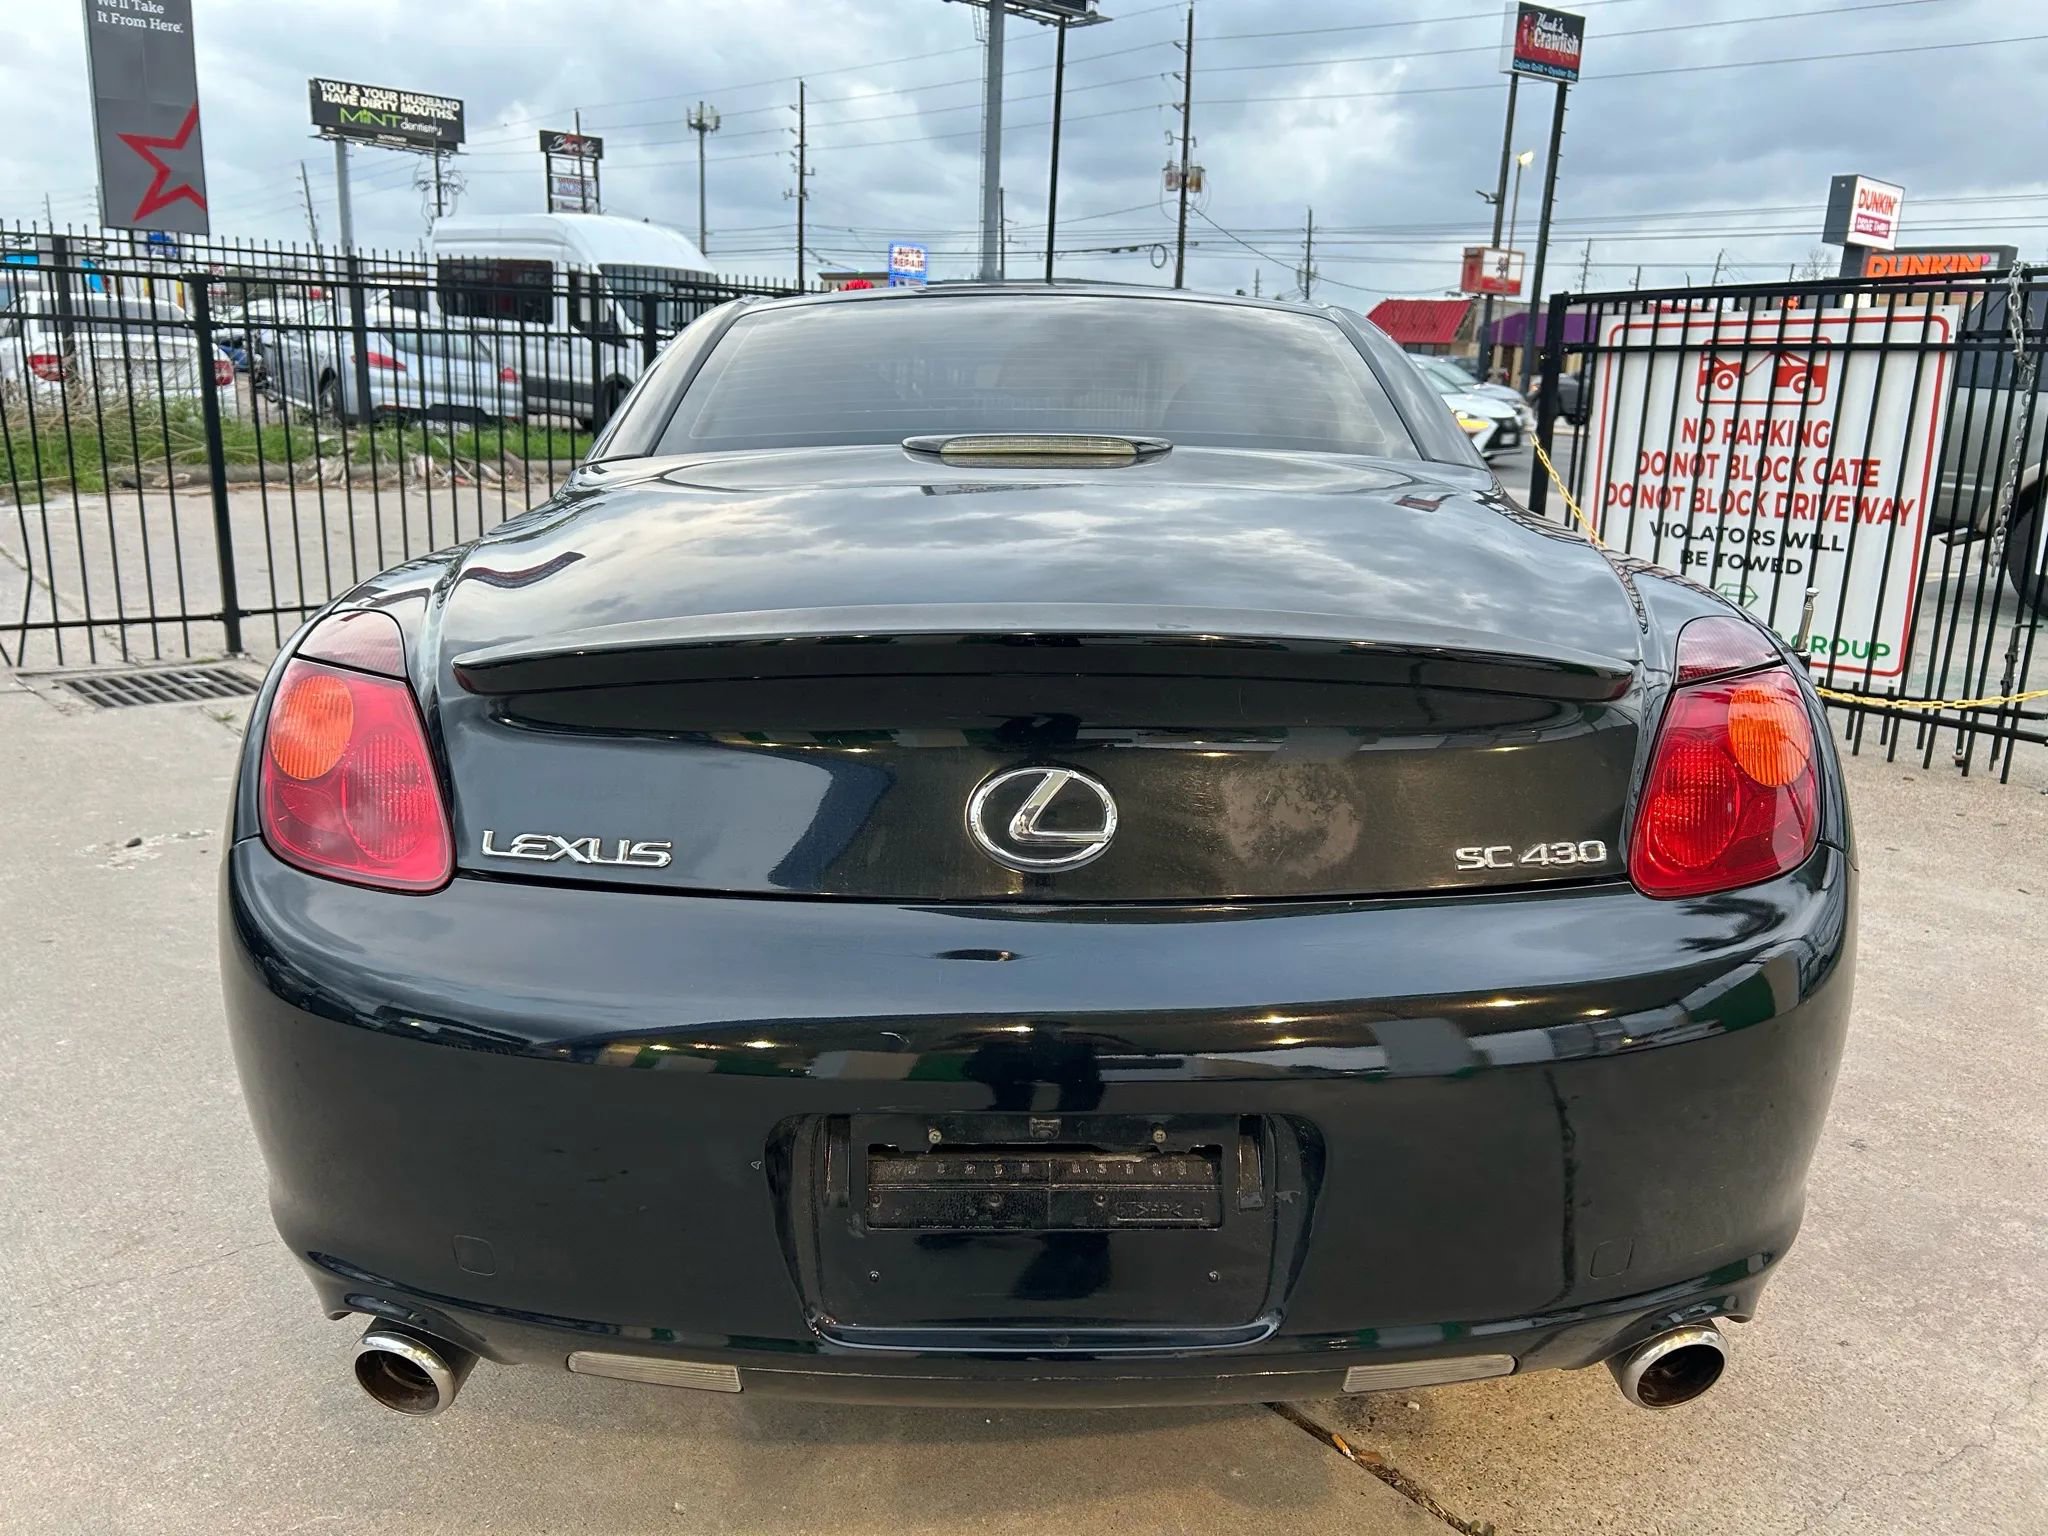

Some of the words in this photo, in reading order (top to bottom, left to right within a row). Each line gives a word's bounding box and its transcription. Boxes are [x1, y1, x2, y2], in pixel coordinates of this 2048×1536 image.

[97, 10, 108, 23] It
[110, 12, 147, 28] From
[132, 0, 164, 14] Take
[1534, 27, 1579, 56] Crawfish
[318, 80, 346, 94] YOU
[349, 85, 360, 97] &
[362, 86, 398, 102] YOUR
[400, 93, 460, 112] HUSBAND
[322, 92, 358, 106] HAVE
[360, 96, 398, 112] DIRTY
[1682, 416, 1715, 445] NO
[1722, 418, 1831, 448] PARKING
[1638, 450, 1667, 476] DO
[1673, 452, 1720, 479] NOT
[1729, 454, 1805, 485] BLOCK
[1812, 457, 1881, 488] GATE
[1607, 482, 1634, 507] DO
[1640, 484, 1686, 512] NOT
[1693, 489, 1768, 518] BLOCK
[1774, 492, 1916, 527] DRIVEWAY
[1649, 520, 1776, 546] VIOLATORS
[1784, 531, 1845, 552] WILL
[1681, 548, 1708, 567] BE
[1715, 552, 1803, 576] TOWED
[481, 829, 673, 868] LEXUS
[1455, 845, 1514, 871] SC
[1519, 840, 1607, 866] 430
